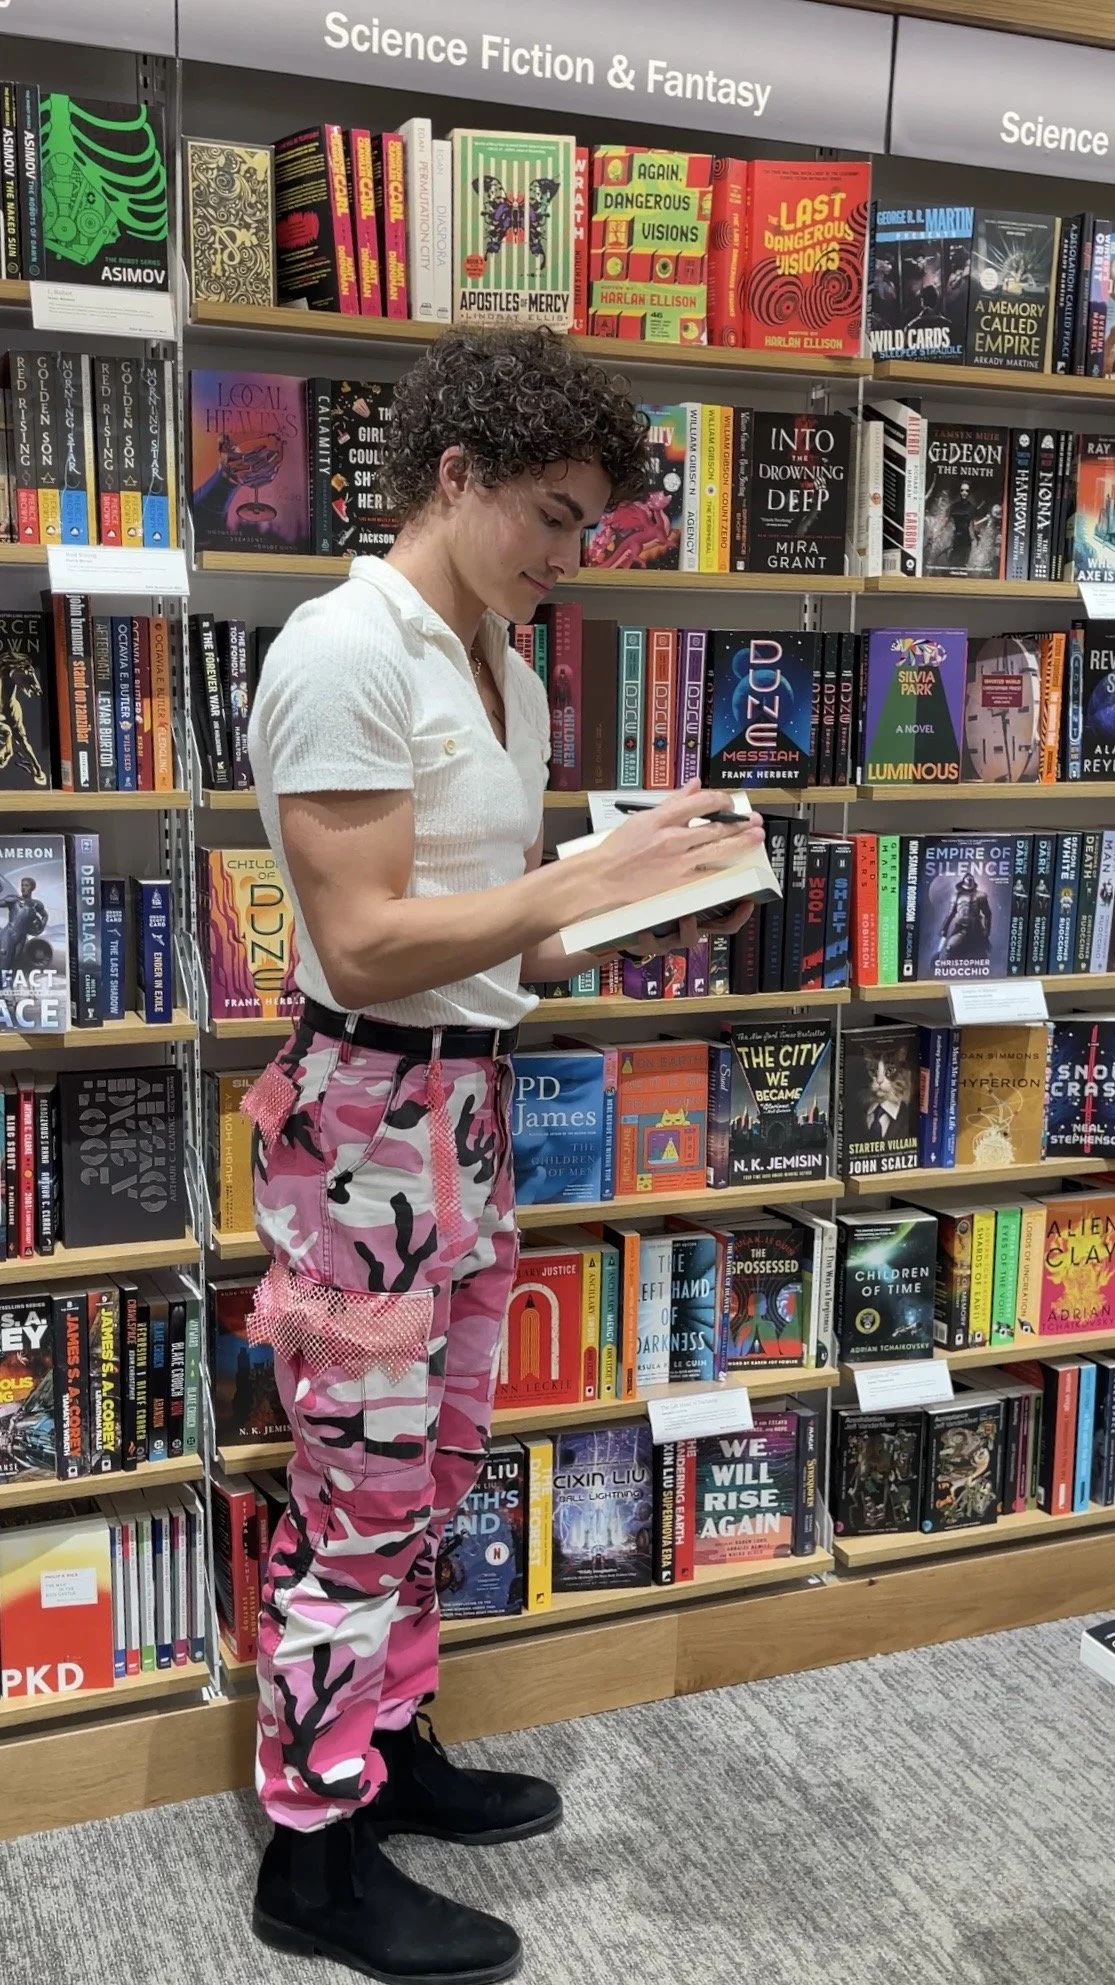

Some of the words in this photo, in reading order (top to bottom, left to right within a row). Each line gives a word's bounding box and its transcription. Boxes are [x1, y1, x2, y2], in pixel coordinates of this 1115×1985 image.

[324, 11, 467, 66] Science
[481, 34, 594, 86] Fiction
[607, 54, 635, 90] &
[647, 60, 771, 116] Fantasy
[1000, 111, 1109, 156] Science
[3, 129, 15, 177] ASIMOV
[436, 149, 444, 175] EGAN
[638, 163, 683, 183] AGAIN,
[6, 180, 14, 198] THE
[574, 159, 586, 240] WRATH
[418, 161, 430, 242] PERMUTATION
[604, 193, 691, 211] DANGEROUS
[780, 192, 847, 232] LAST
[6, 201, 16, 237] NAKED
[877, 211, 907, 225] GEORGE
[916, 210, 924, 224] R.
[925, 206, 974, 233] MARTIN
[436, 205, 447, 267] DIASPORA
[642, 222, 699, 243] VISIONS
[763, 221, 855, 253] DANGEROUS
[8, 239, 17, 257] SUN
[420, 245, 430, 271] CITY
[776, 241, 841, 275] VISIONS
[102, 266, 165, 285] ASIMOV
[460, 291, 520, 313] APOSTLES
[528, 292, 570, 313] MERCY
[600, 292, 645, 306] HARLAN
[649, 294, 696, 308] ELLISON
[975, 303, 984, 312] A
[988, 302, 1045, 318] MEMORY
[980, 316, 1038, 335] CALLED
[765, 335, 800, 349] HARLAN
[804, 337, 843, 350] ELLISON
[870, 330, 905, 352] WILD
[908, 327, 950, 350] CARDS
[975, 333, 1040, 357] EMPIRE
[17, 357, 27, 390] RED
[37, 357, 50, 425] GOLDEN
[217, 382, 287, 411] LOCAL
[19, 398, 31, 466] RISING
[318, 396, 331, 476] CALAMITY
[771, 427, 835, 454] INTO
[42, 431, 53, 465] SON
[1087, 442, 1110, 455] RAY
[758, 463, 844, 482] DROWNING
[936, 465, 958, 475] THE
[960, 466, 993, 477] NINTH
[768, 488, 830, 513] DEEP
[1013, 469, 1029, 538] HARROW
[1038, 471, 1053, 530] NONA
[776, 540, 819, 554] MIRA
[767, 555, 827, 570] GRANT
[67, 594, 85, 616] john
[71, 617, 86, 658] brunner
[203, 631, 212, 650] THE
[96, 624, 110, 680] AFTERMATH
[230, 642, 238, 678] FONDLY
[205, 652, 217, 699] FOREVER
[898, 670, 935, 684] SILVIA
[744, 639, 783, 748] DUNE
[900, 683, 933, 697] PARK
[98, 690, 112, 727] LEVAR
[210, 701, 220, 718] WAR
[625, 685, 638, 734] DUNE
[655, 686, 668, 734] DUNE
[100, 729, 113, 767] BURTON
[723, 751, 800, 762] MESSIAH
[722, 770, 753, 779] FRANK
[757, 770, 800, 780] HERBERT
[868, 762, 959, 780] LUMINOUS
[792, 833, 807, 890] SHIFT
[925, 847, 986, 860] EMPIRE
[989, 847, 1011, 860] OF
[925, 861, 1010, 877] SILENCE
[81, 865, 95, 906] DEEP
[808, 877, 826, 923] WOOL
[833, 878, 848, 933] SHIFT
[82, 912, 96, 963] BLACK
[109, 940, 118, 955] THE
[250, 884, 285, 991] DUNE
[109, 956, 119, 975] LAST
[153, 952, 162, 979] ENDER
[934, 959, 990, 967] CHRISTOPHER
[934, 967, 990, 976] RUOCCHIO
[109, 976, 119, 1015] SHADOW
[153, 980, 162, 989] IN
[153, 990, 164, 1013] EXILE
[225, 998, 261, 1008] FRANK
[736, 1045, 775, 1069] THE
[779, 1042, 826, 1067] CITY
[515, 1075, 561, 1101] PD
[766, 1071, 791, 1087] WE
[960, 1078, 1041, 1089] HYPERION
[755, 1087, 803, 1102] BECAME
[7, 1115, 15, 1139] RING
[512, 1103, 597, 1136] James
[7, 1141, 16, 1171] SHOUT
[573, 1142, 595, 1152] THE
[849, 1141, 885, 1154] STARTER
[887, 1137, 918, 1151] VILLAIN
[531, 1154, 596, 1166] CHILDREN
[734, 1159, 749, 1173] N.
[751, 1158, 764, 1172] K.
[766, 1154, 823, 1170] JEMISIN
[848, 1160, 877, 1175] JOHN
[881, 1155, 918, 1171] SCALZI
[548, 1167, 563, 1178] OF
[569, 1167, 595, 1178] MEN
[41, 1172, 50, 1198] ARTHUR
[42, 1199, 50, 1208] C.
[42, 1210, 52, 1236] CLARKE
[1047, 1216, 1115, 1239] ALIEN
[751, 1248, 767, 1259] THE
[1046, 1243, 1115, 1269] CLAY
[541, 1265, 576, 1277] JUSTICE
[854, 1266, 930, 1282] CHILDREN
[861, 1285, 881, 1297] OF
[888, 1283, 922, 1295] TIME
[1047, 1305, 1112, 1323] ADRIAN
[67, 1313, 80, 1365] JAMES
[101, 1308, 114, 1360] JAMES
[850, 1345, 878, 1354] ADRIAN
[880, 1342, 931, 1353] TCHAIKOVSKY
[68, 1368, 80, 1383] S.
[101, 1361, 114, 1378] S.
[69, 1386, 81, 1404] A.
[102, 1380, 115, 1397] A.
[62, 1393, 70, 1427] TIAMAT'S
[69, 1405, 82, 1458] COREY
[102, 1399, 116, 1453] COREY
[63, 1427, 71, 1457] WRATH
[719, 1437, 768, 1459] WE
[486, 1463, 519, 1480] LIU
[553, 1474, 605, 1489] CIXIN
[613, 1470, 646, 1485] LIU
[711, 1462, 774, 1487] WILL
[559, 1494, 583, 1504] BALL
[589, 1490, 643, 1502] LIGHTNING
[704, 1488, 779, 1512] RISE
[700, 1512, 781, 1539] AGAIN
[1, 1662, 85, 1698] PKD
